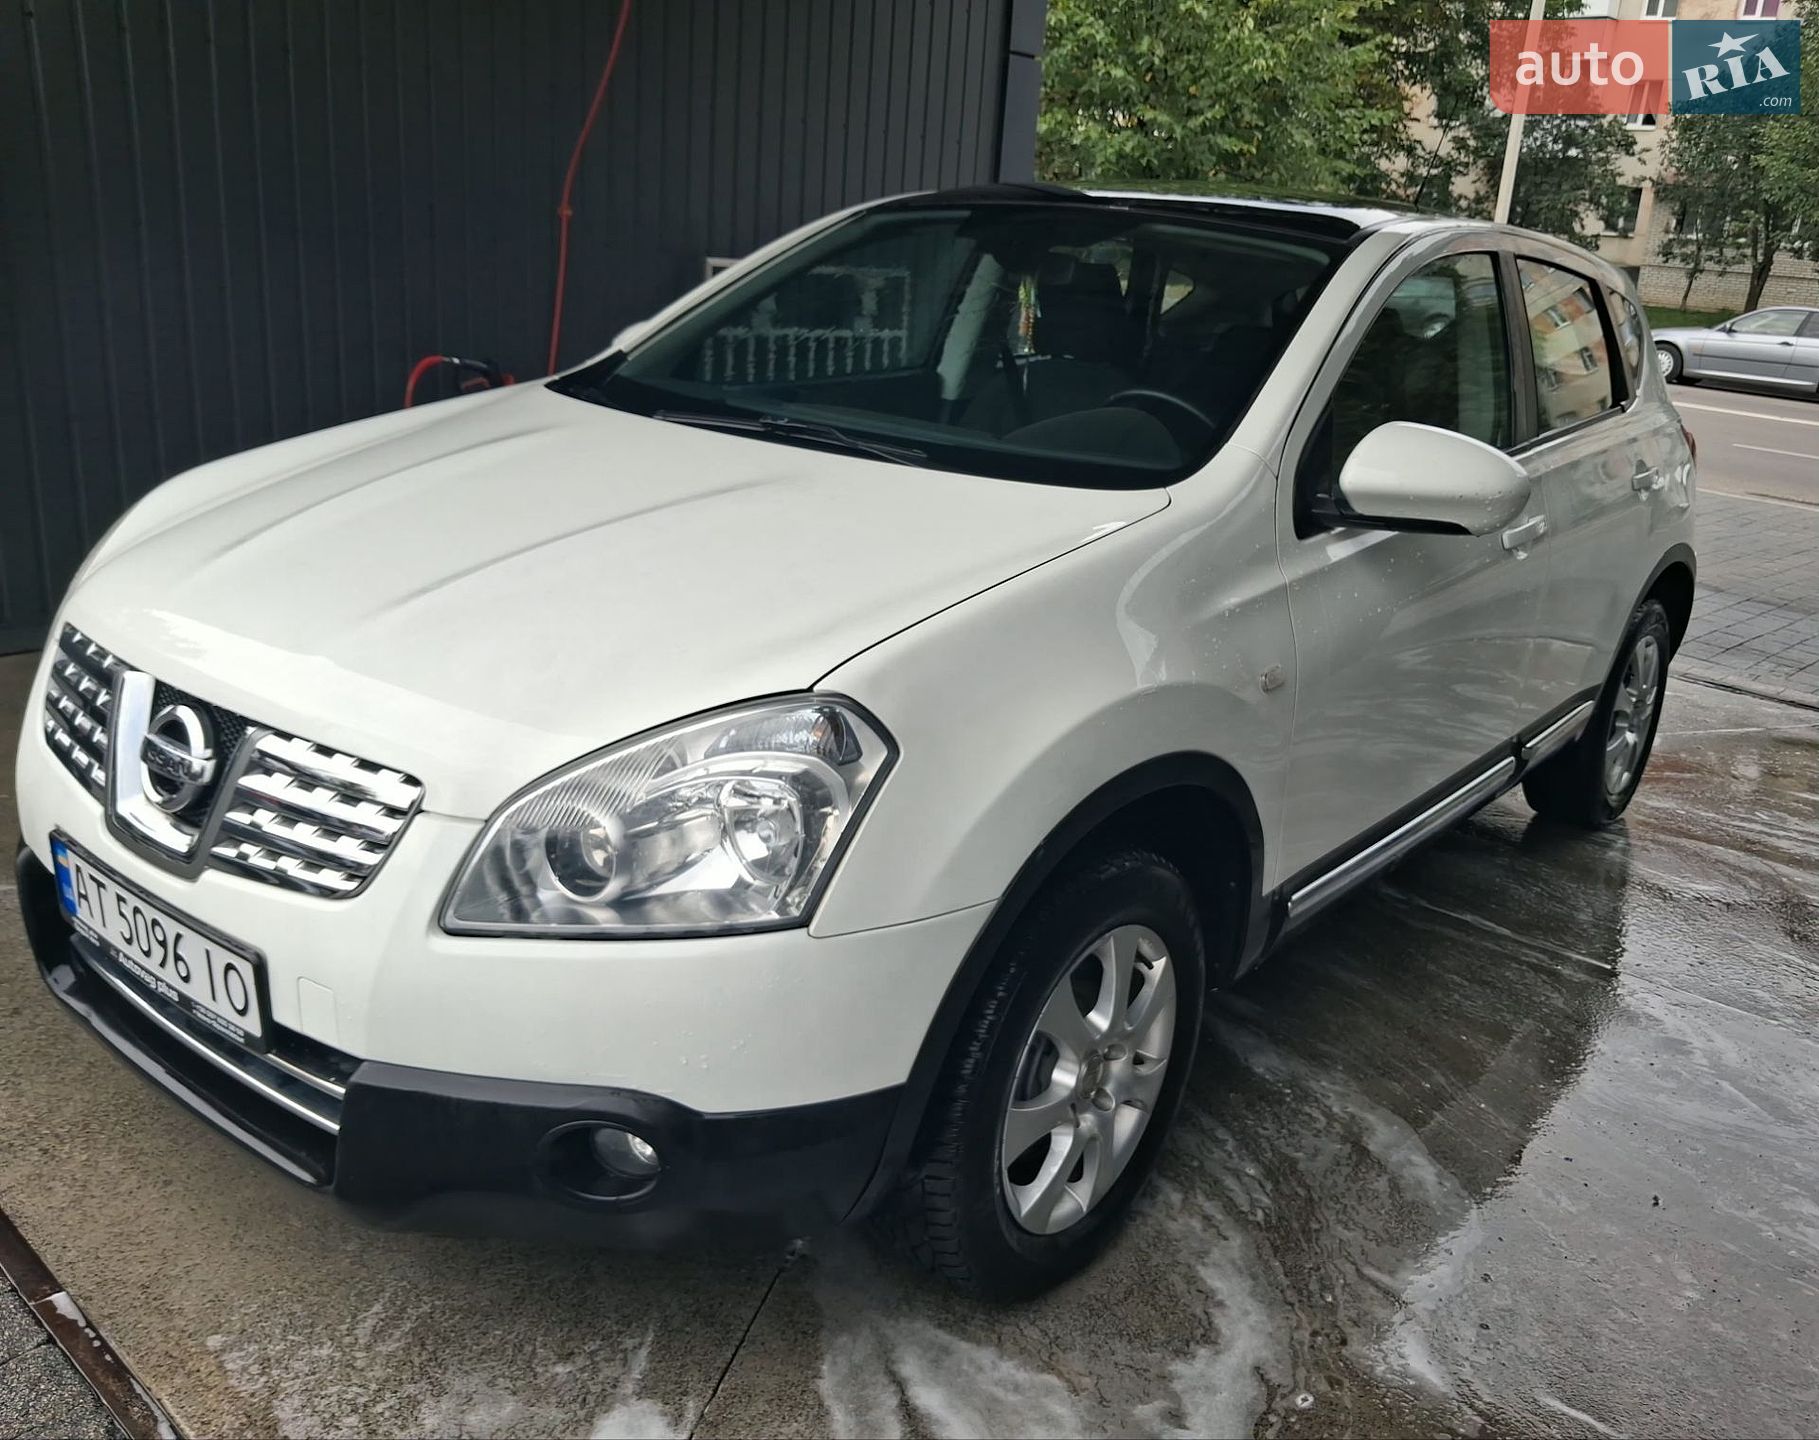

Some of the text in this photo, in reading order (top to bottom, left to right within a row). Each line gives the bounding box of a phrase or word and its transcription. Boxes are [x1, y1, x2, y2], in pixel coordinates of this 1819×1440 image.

[75, 863, 249, 1017] AT 5096 IO
